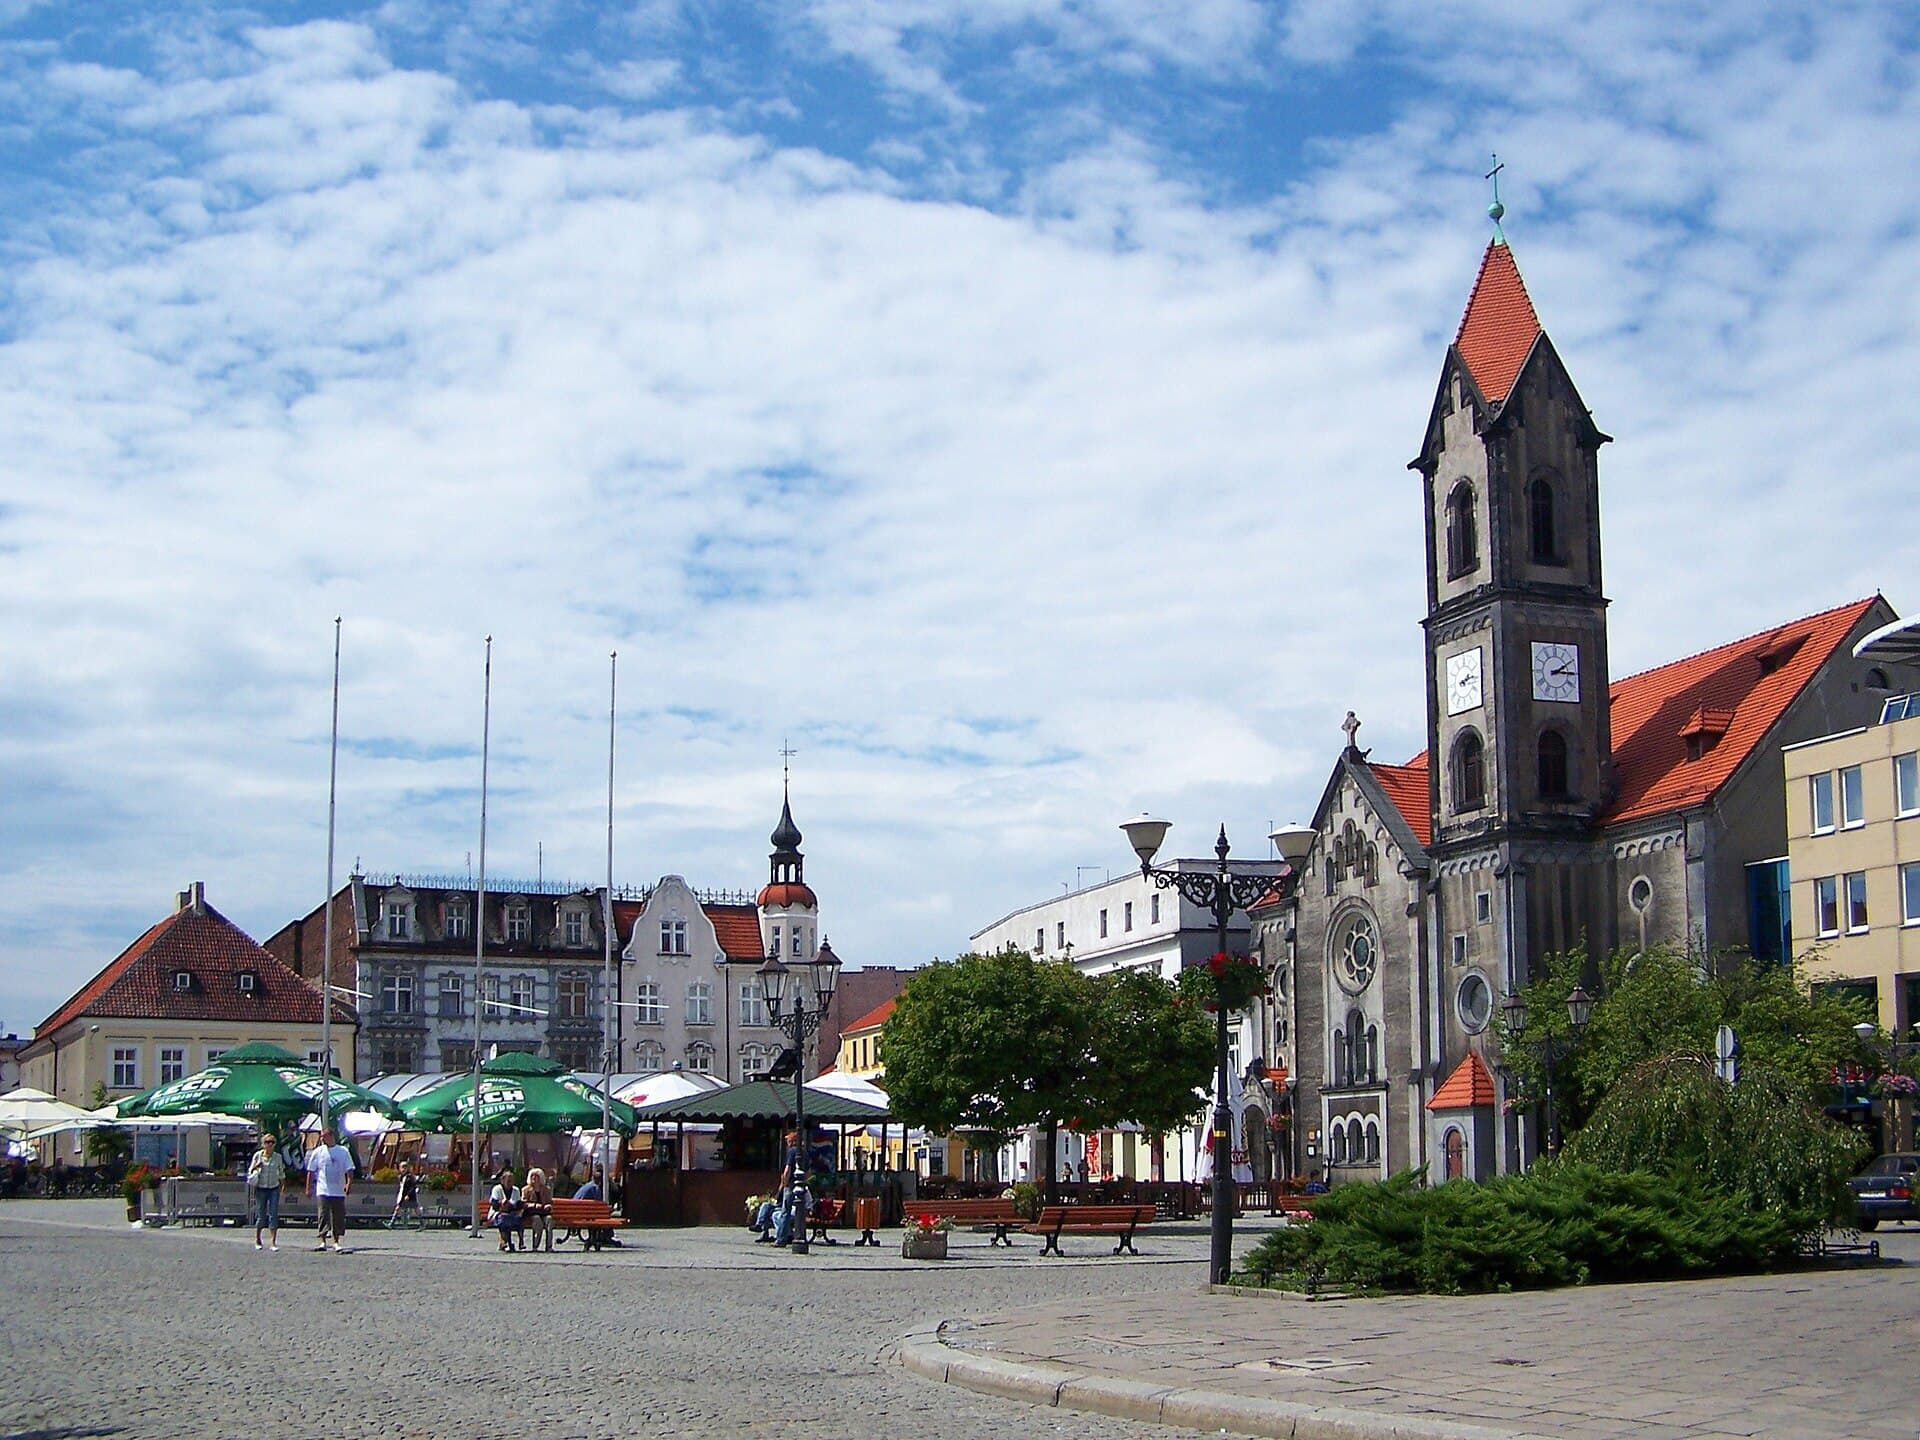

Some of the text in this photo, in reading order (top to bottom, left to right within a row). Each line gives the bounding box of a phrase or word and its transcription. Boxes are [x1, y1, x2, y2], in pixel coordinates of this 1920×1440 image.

[149, 1078, 225, 1101] LECH
[456, 1090, 524, 1111] LECH
[468, 1103, 516, 1124] PEMIUM
